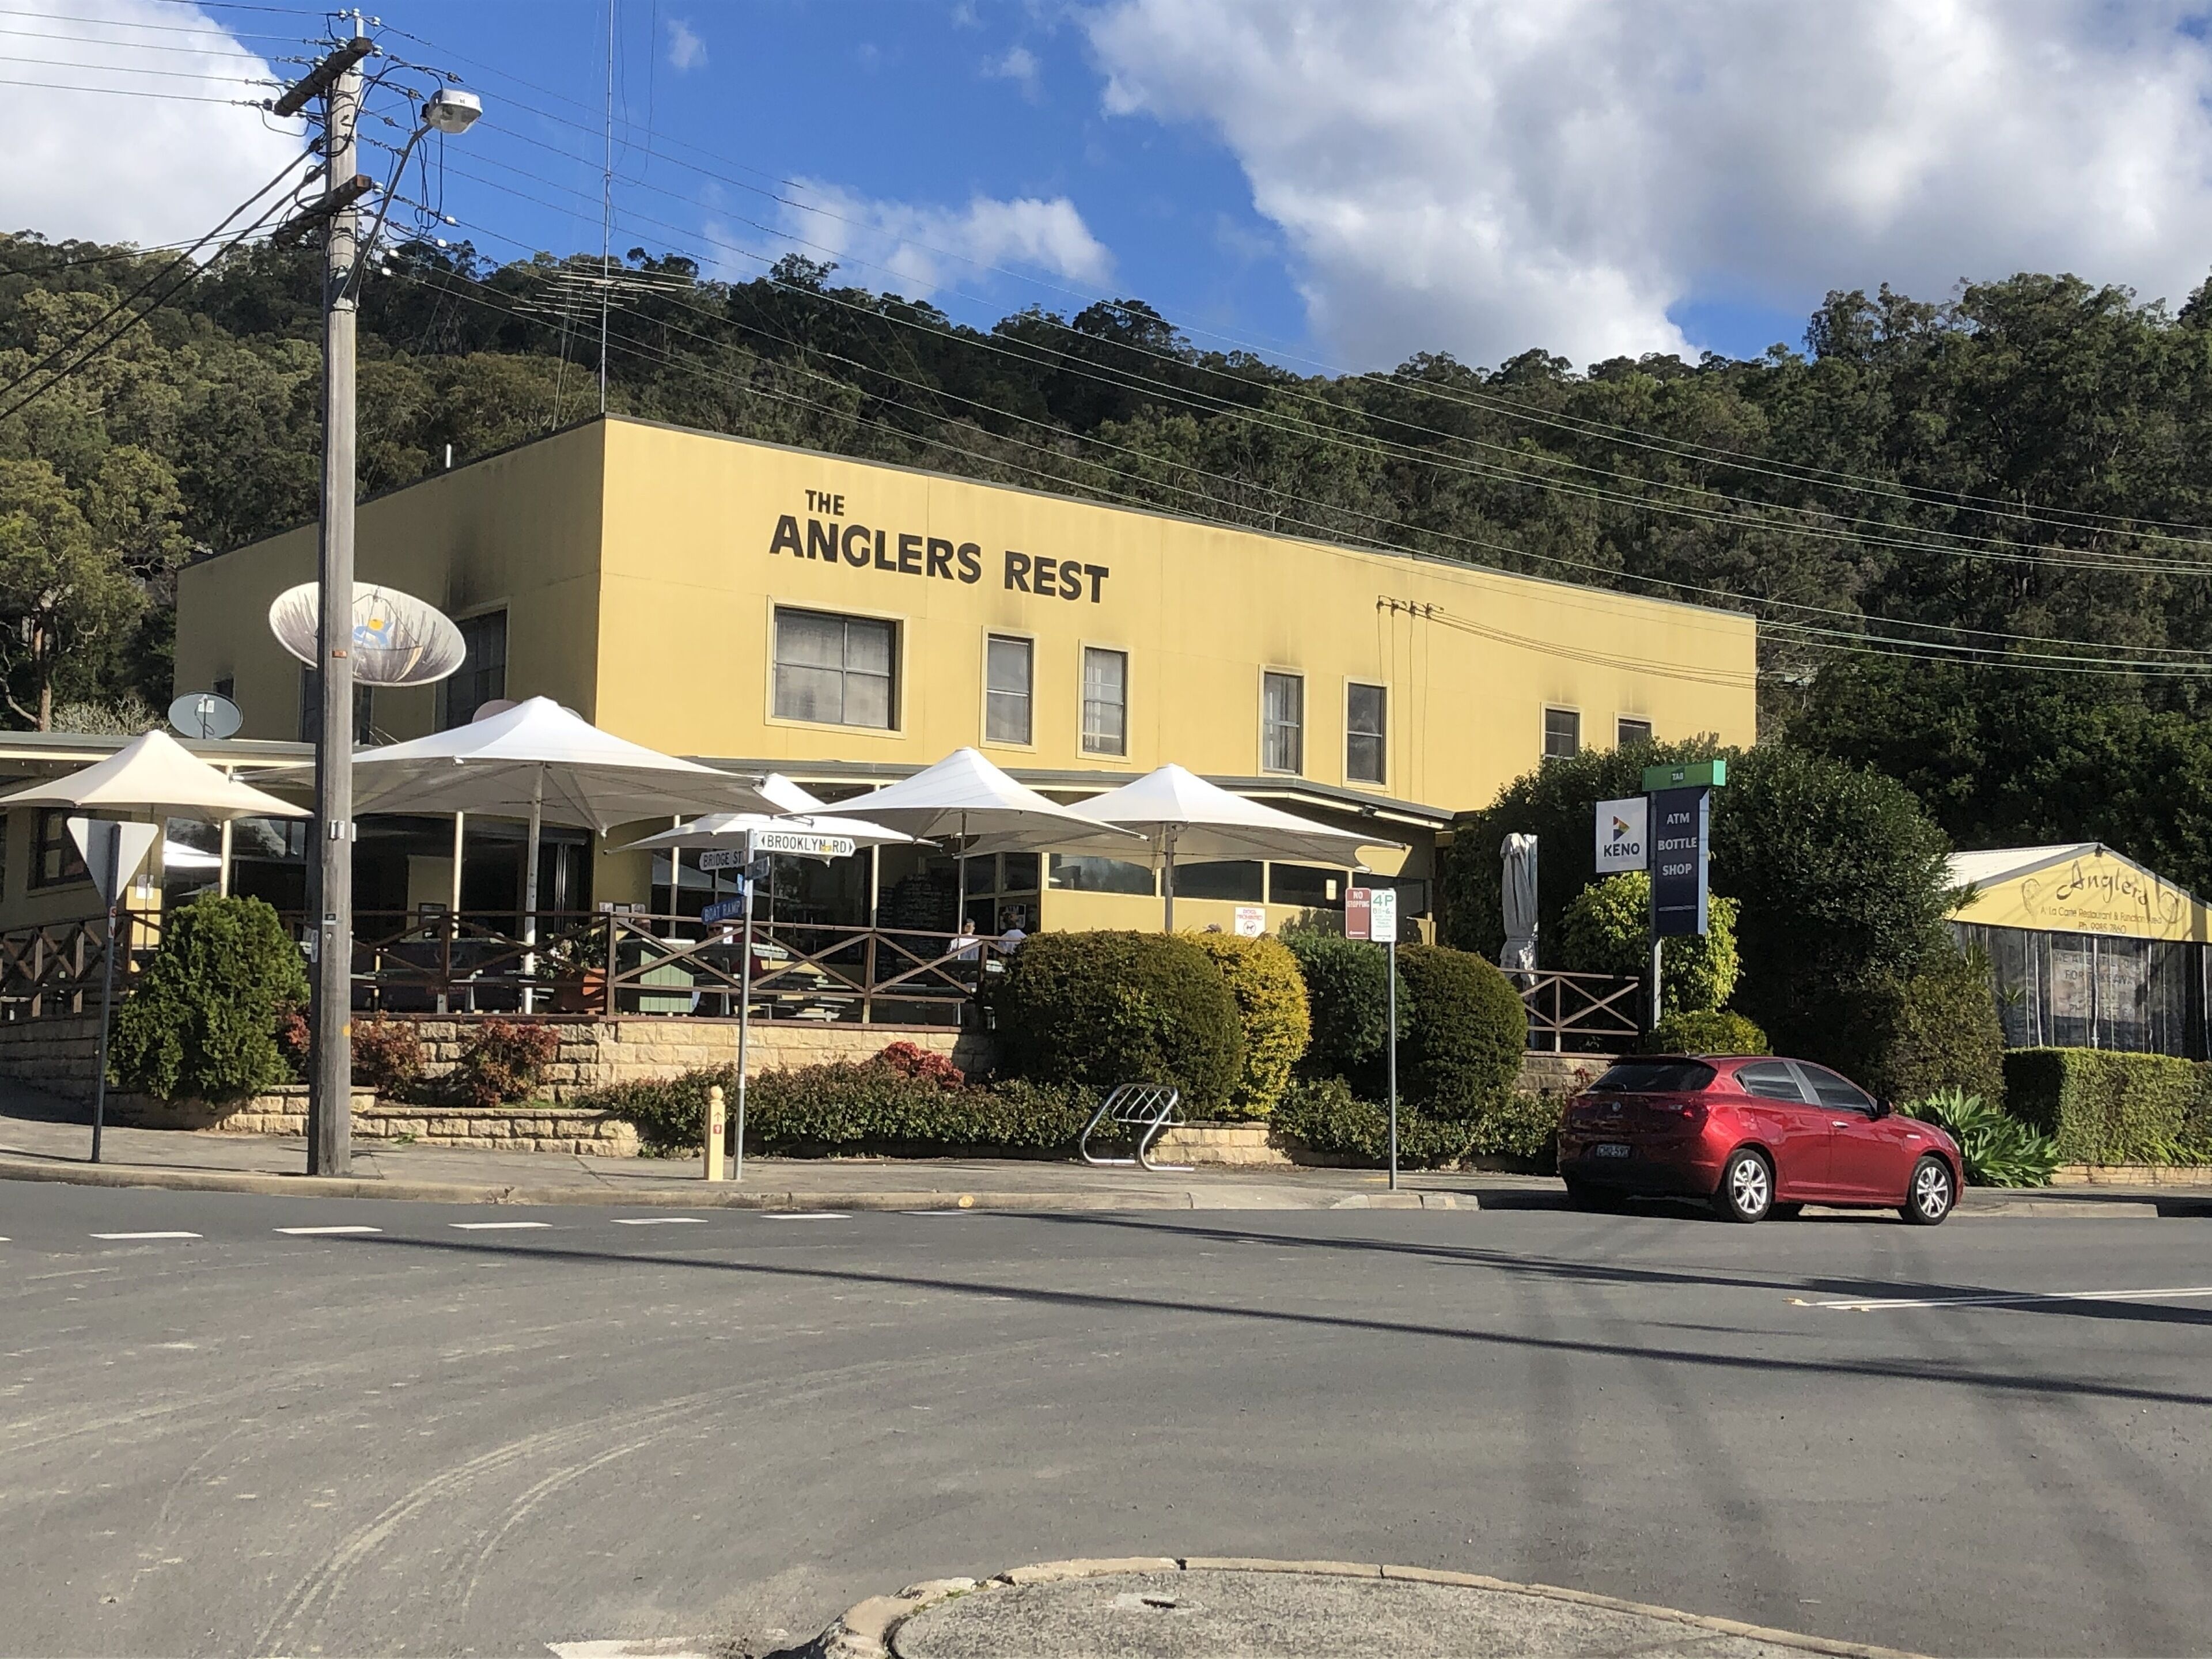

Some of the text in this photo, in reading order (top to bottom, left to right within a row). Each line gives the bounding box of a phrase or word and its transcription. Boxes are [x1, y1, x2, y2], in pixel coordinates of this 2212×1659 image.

[805, 489, 844, 516] THE
[769, 514, 1109, 604] ANGLERS REST
[1666, 813, 1690, 824] ATM
[767, 835, 847, 853] BROOKLYN RD
[1604, 843, 1640, 857] KENO
[1657, 837, 1698, 851] BOTTLE
[703, 851, 742, 868] BRIDGE ST
[1662, 863, 1692, 876] SHOP
[1353, 891, 1363, 899] NO
[1373, 895, 1394, 907] 4P
[704, 900, 741, 922] BOAT RAMP
[2078, 908, 2112, 921] Restaurant
[2066, 969, 2084, 980] FOR
